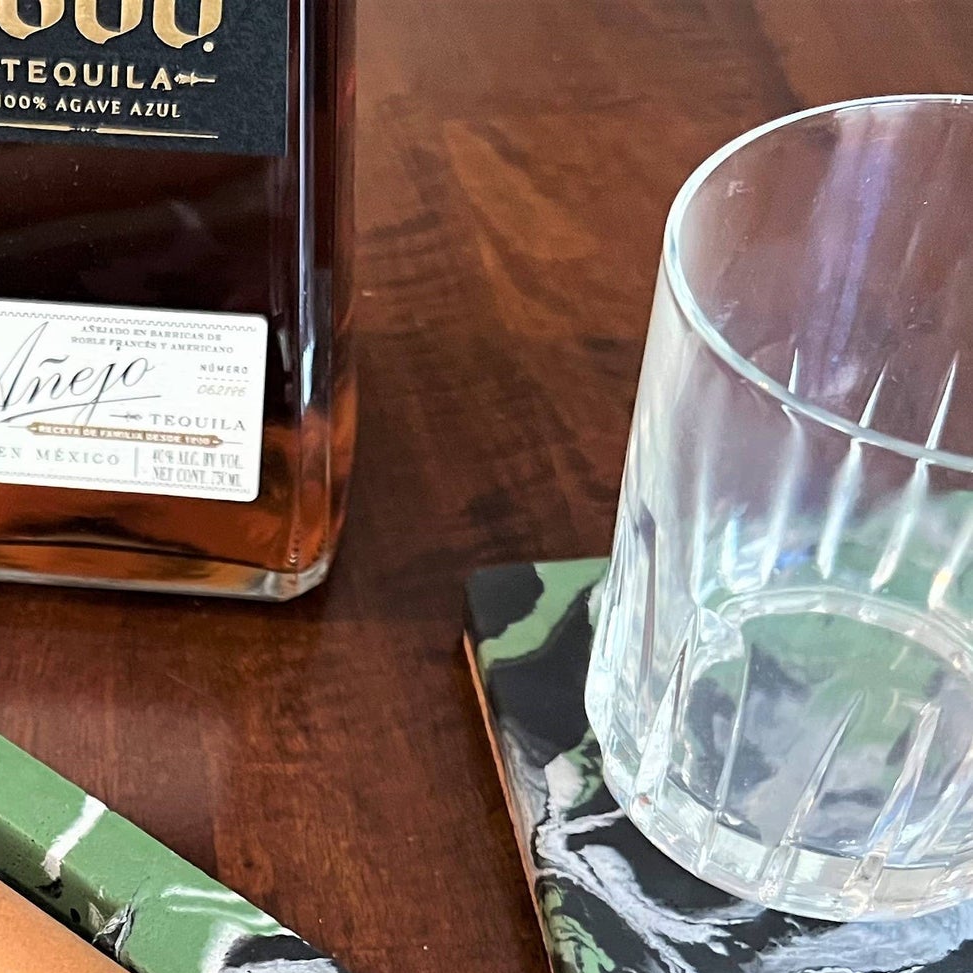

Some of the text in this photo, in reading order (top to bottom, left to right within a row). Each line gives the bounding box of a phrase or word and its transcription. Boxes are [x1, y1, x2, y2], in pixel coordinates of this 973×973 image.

[0, 58, 172, 91] TEQUILA
[55, 98, 121, 115] AGAVE
[130, 102, 181, 118] AZUL
[134, 328, 147, 337] EN
[150, 330, 205, 341] BARRICAS
[208, 333, 222, 341] DE
[70, 336, 106, 346] ROBLE
[160, 342, 167, 350] Y
[170, 343, 234, 354] AMERICANO
[200, 362, 249, 374] NÚMERO
[149, 413, 247, 431] TEQUILA
[36, 447, 120, 466] MÉXICO
